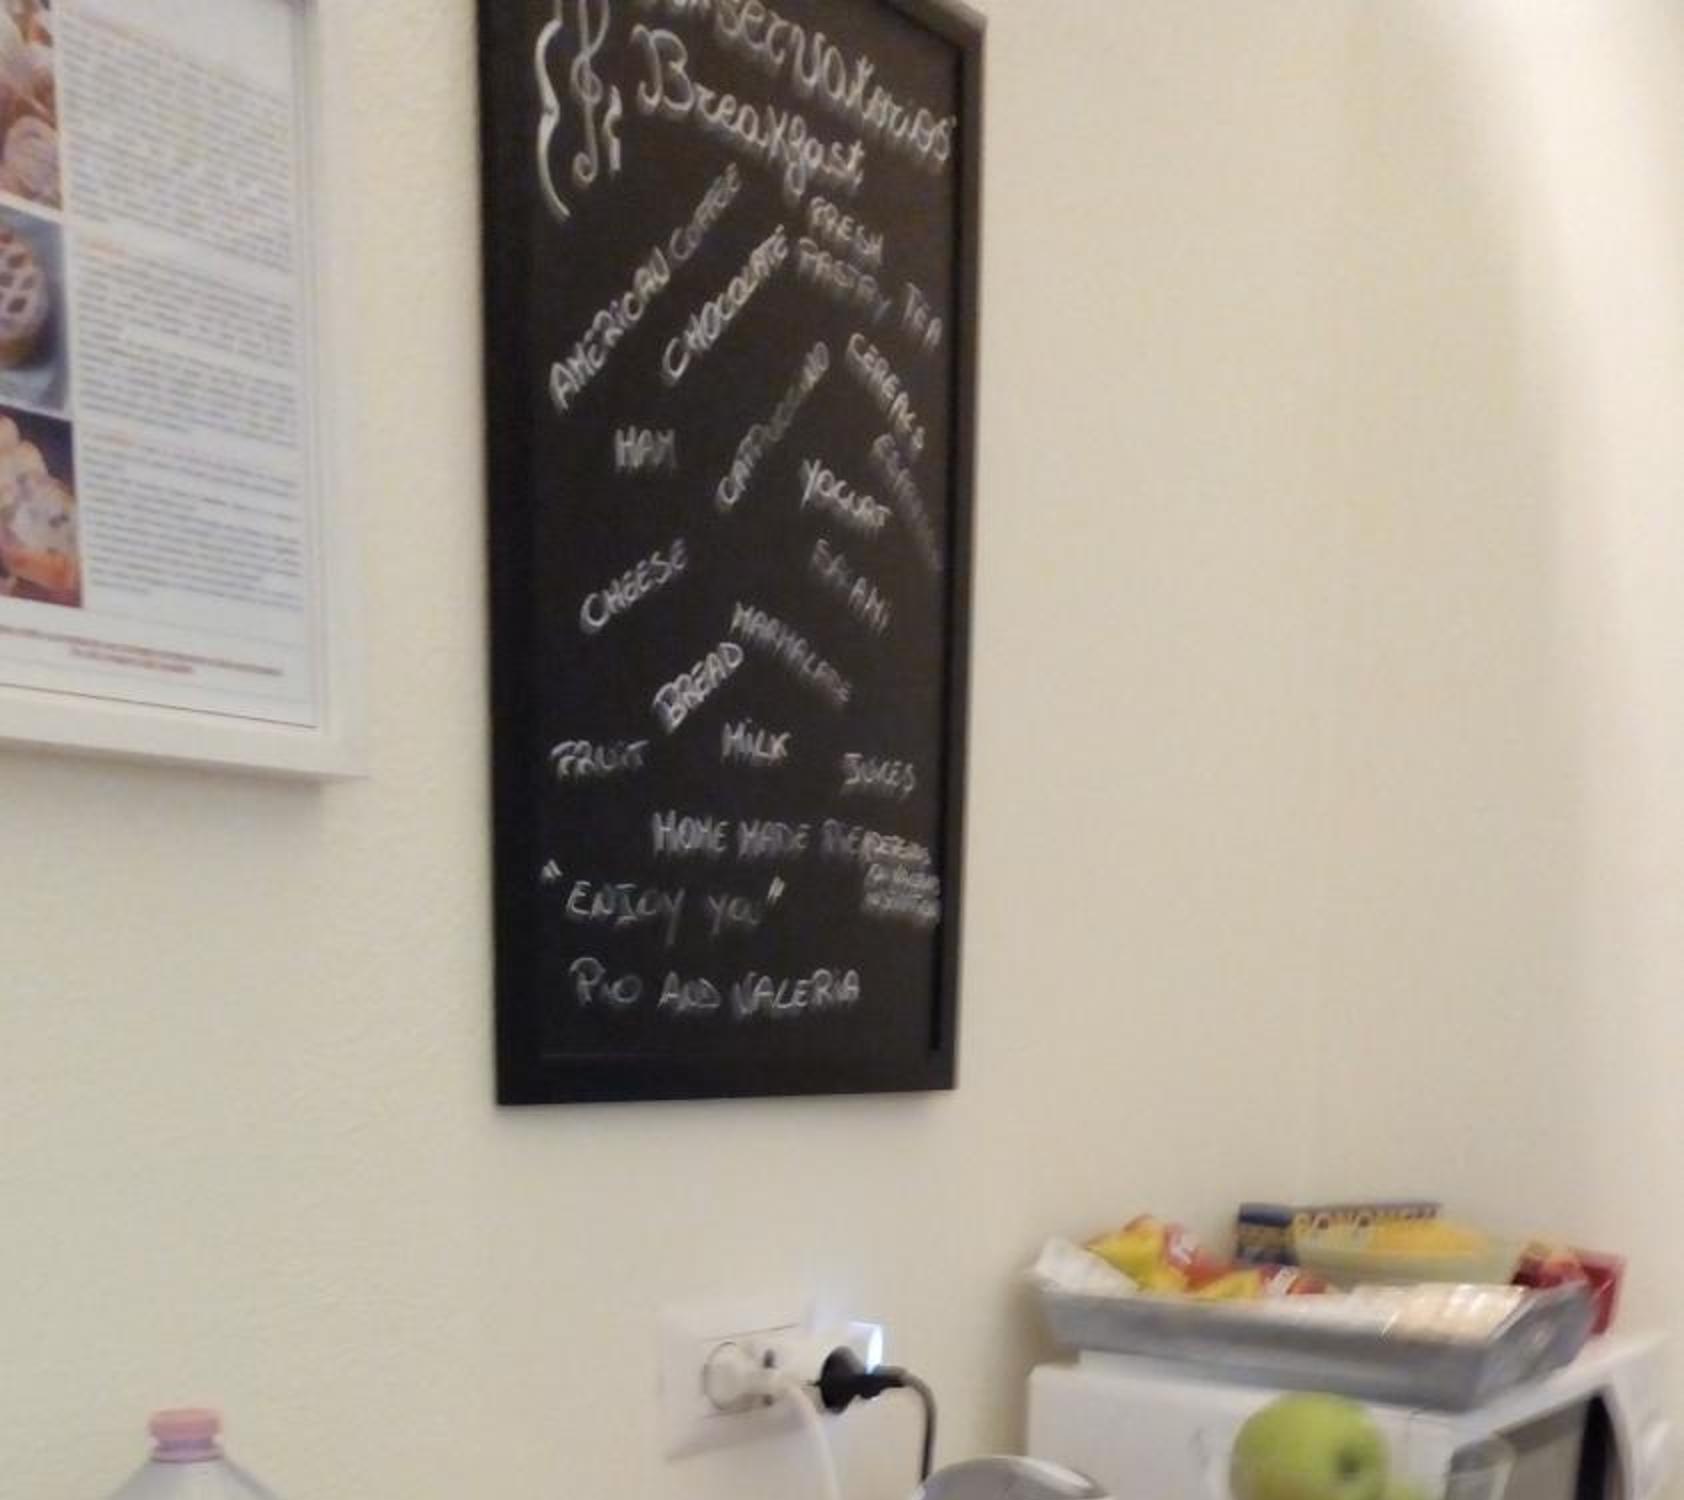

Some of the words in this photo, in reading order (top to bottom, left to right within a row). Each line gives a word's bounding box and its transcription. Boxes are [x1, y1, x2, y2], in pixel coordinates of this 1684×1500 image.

[810, 196, 884, 266] FRESH
[662, 224, 788, 382] CHOCOLATE
[613, 425, 678, 474] HAM
[801, 458, 892, 530] YOGURT
[580, 538, 688, 633] CHEESE
[653, 641, 744, 732] BREAD
[551, 739, 649, 780] FRUIT
[722, 718, 791, 762] MILK
[652, 811, 727, 853] HOME
[737, 819, 811, 860] MADE
[731, 968, 860, 1014] VALERIA
